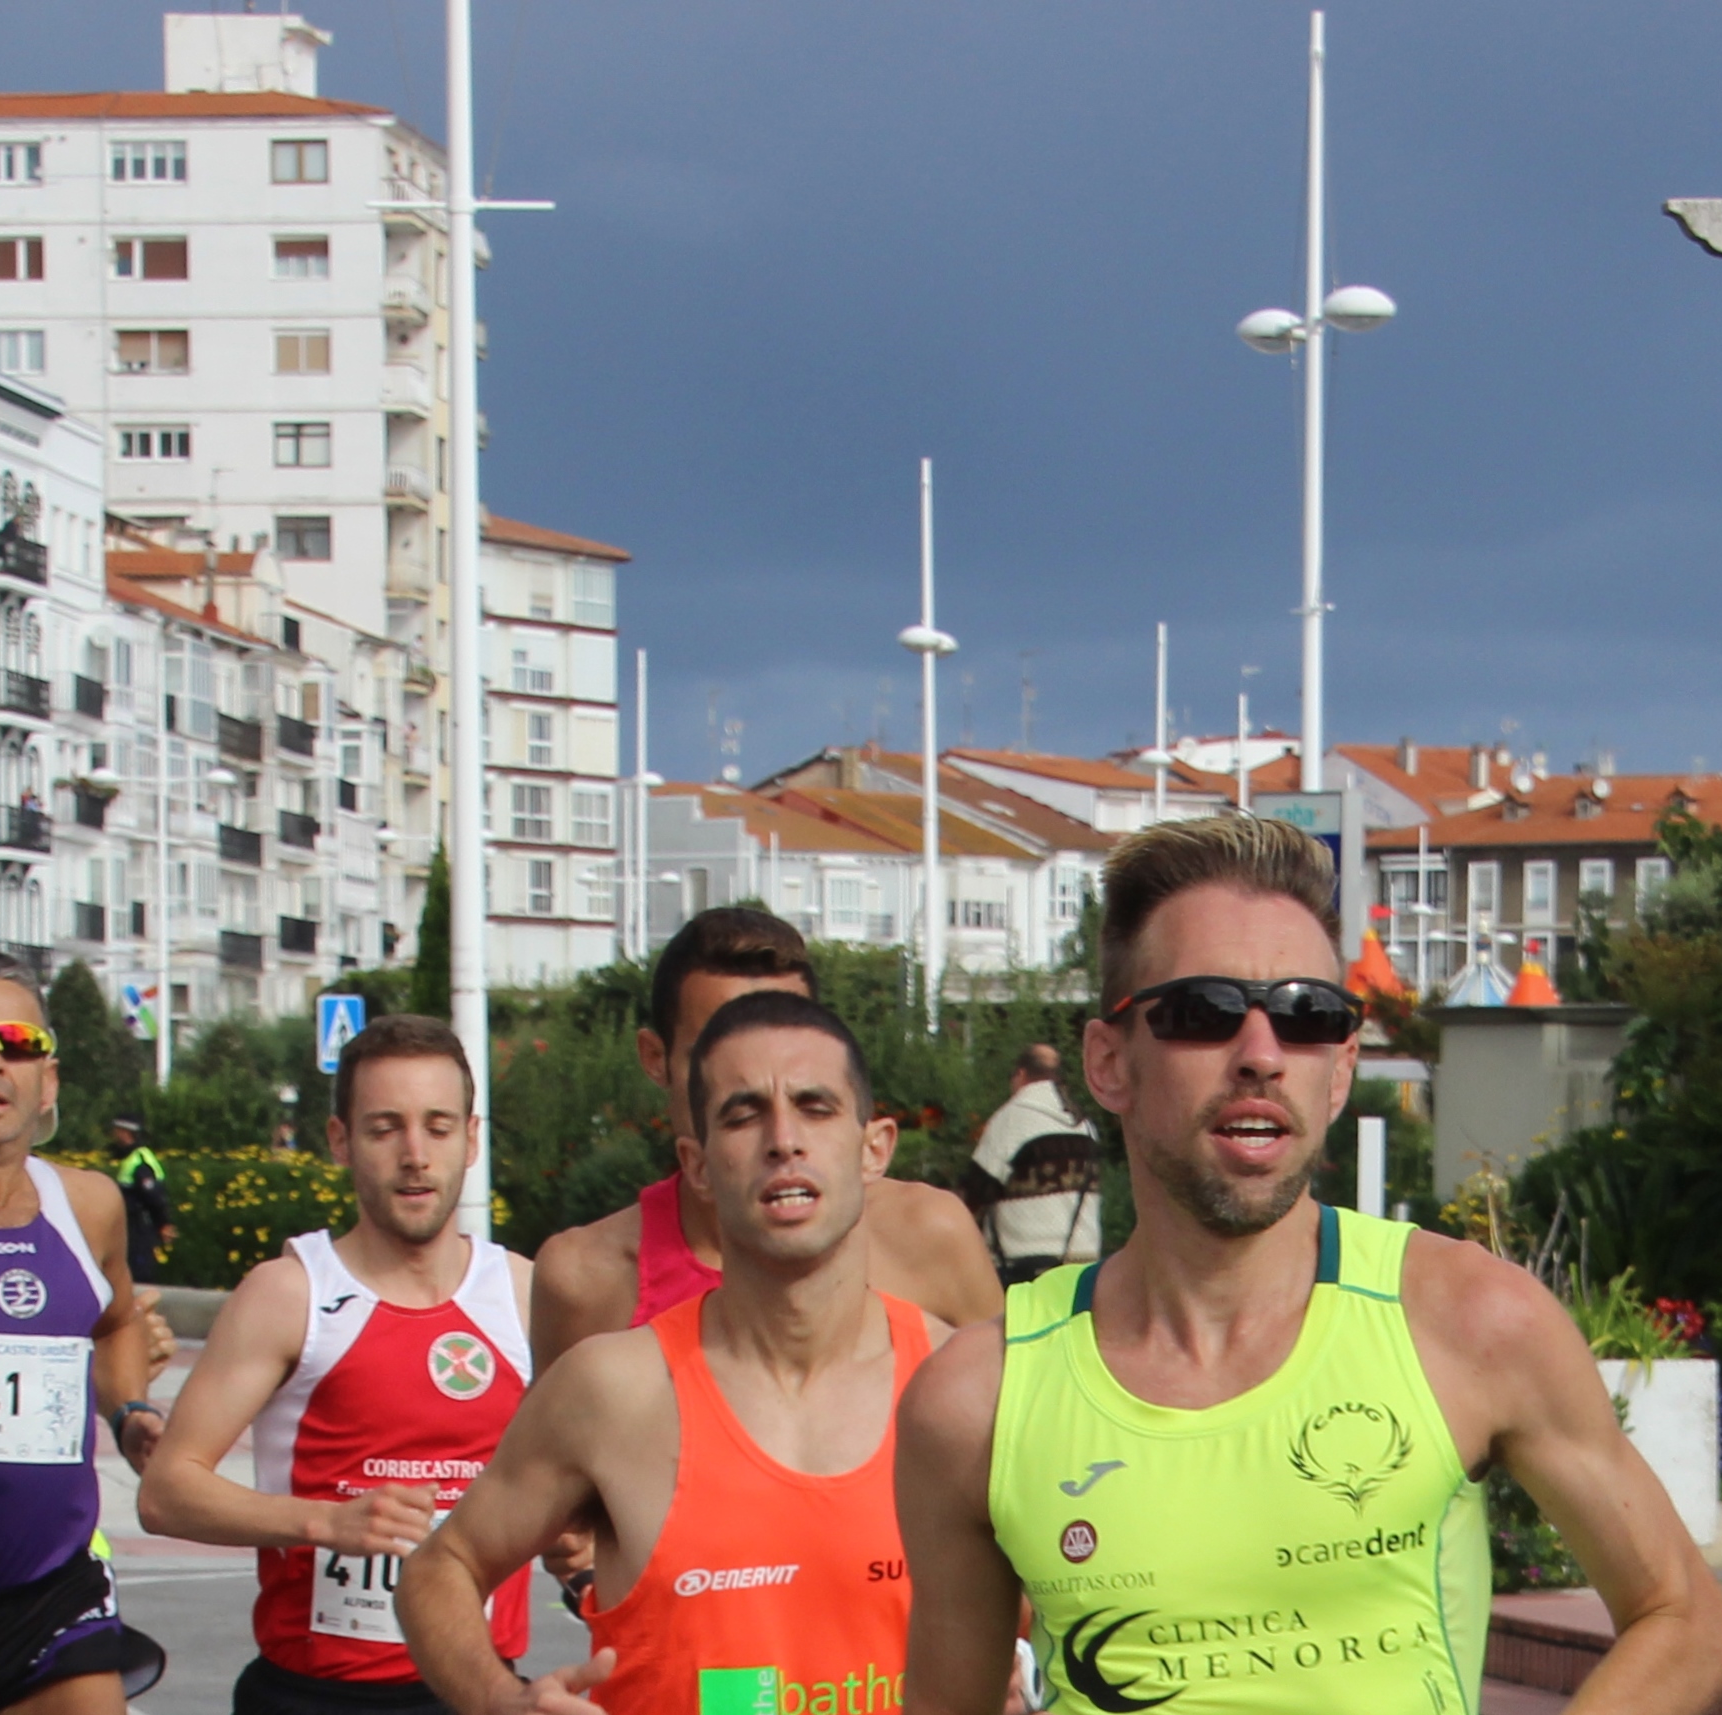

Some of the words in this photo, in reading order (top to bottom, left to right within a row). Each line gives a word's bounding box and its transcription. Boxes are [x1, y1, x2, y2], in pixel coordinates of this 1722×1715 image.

[363, 1458, 485, 1479] CORRECASTRO
[711, 1564, 799, 1591] ENERVIT
[1147, 1608, 1309, 1646] CLINICA
[1157, 1620, 1429, 1682] MENORCA
